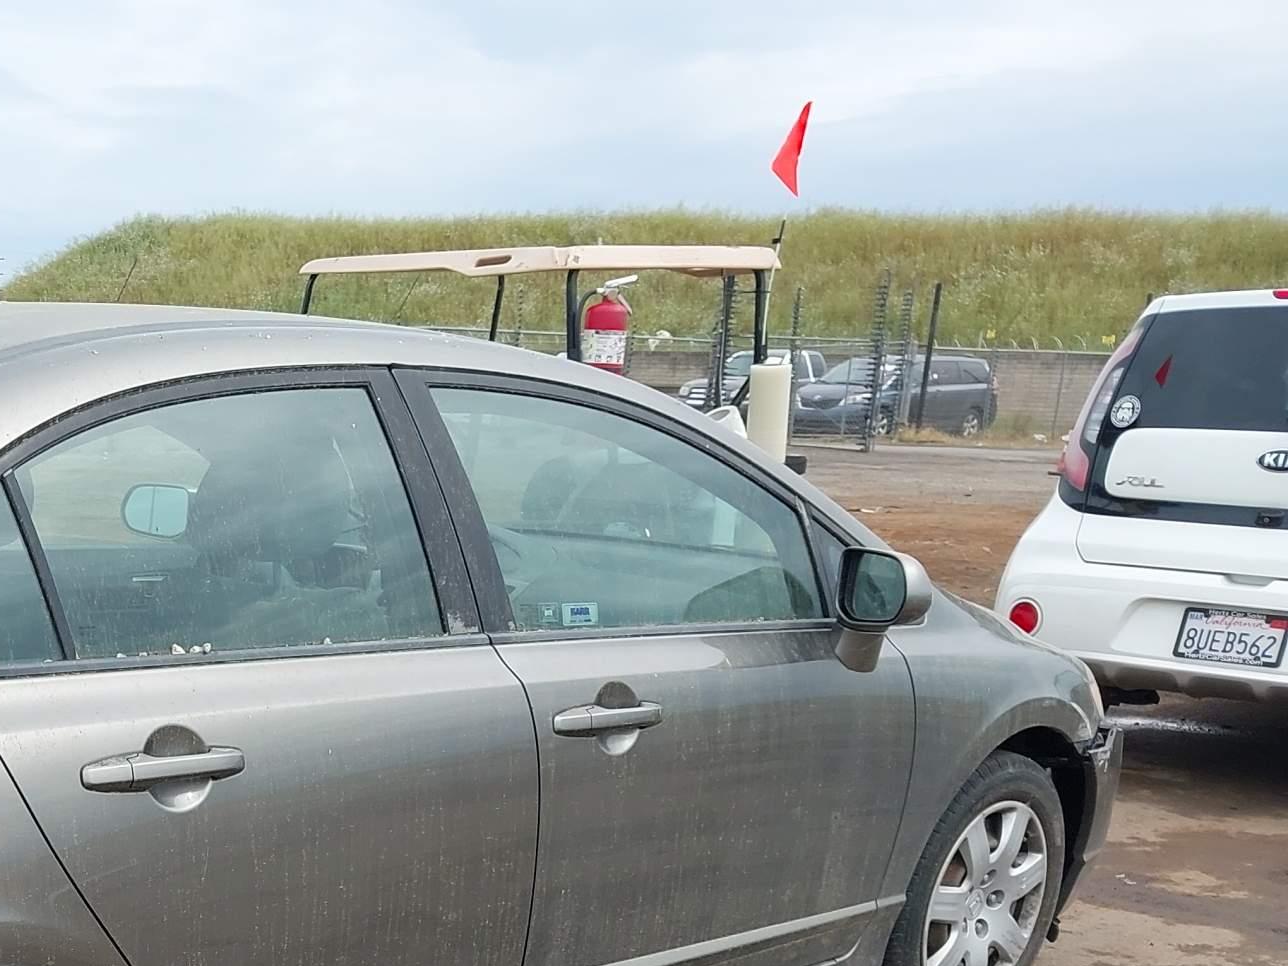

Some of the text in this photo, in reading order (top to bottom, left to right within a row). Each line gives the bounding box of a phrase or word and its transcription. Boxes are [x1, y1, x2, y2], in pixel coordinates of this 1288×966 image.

[1263, 453, 1288, 468] KI
[1205, 614, 1267, 630] California
[1184, 627, 1277, 659] 8UEB562
